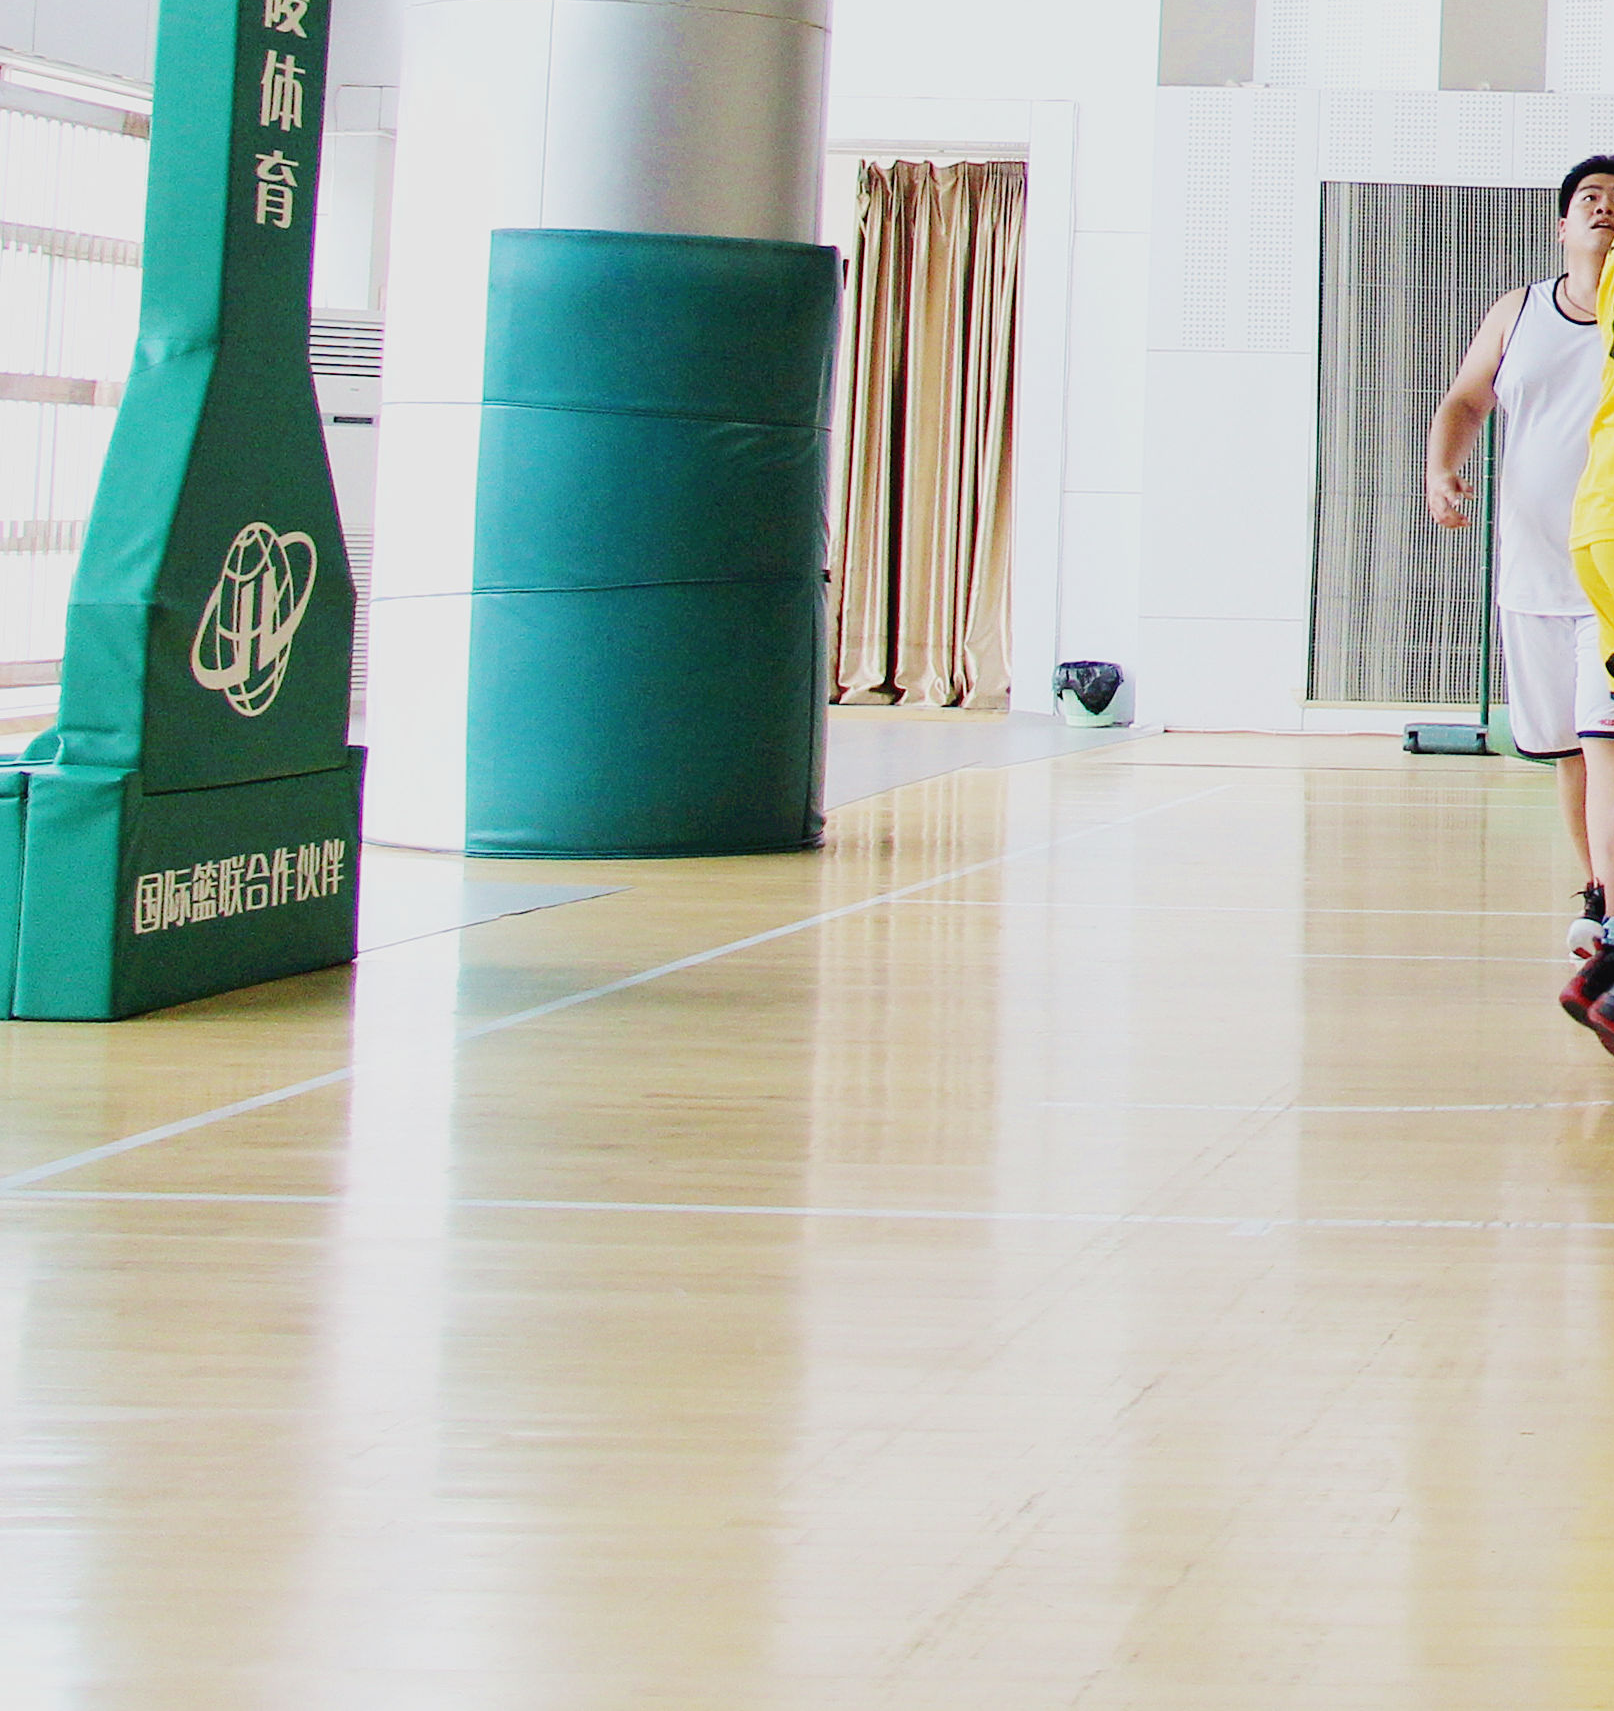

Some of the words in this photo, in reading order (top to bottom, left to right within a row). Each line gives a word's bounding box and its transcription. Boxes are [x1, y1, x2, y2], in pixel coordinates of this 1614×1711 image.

[135, 838, 345, 935] 国际篮联合作伙伴
